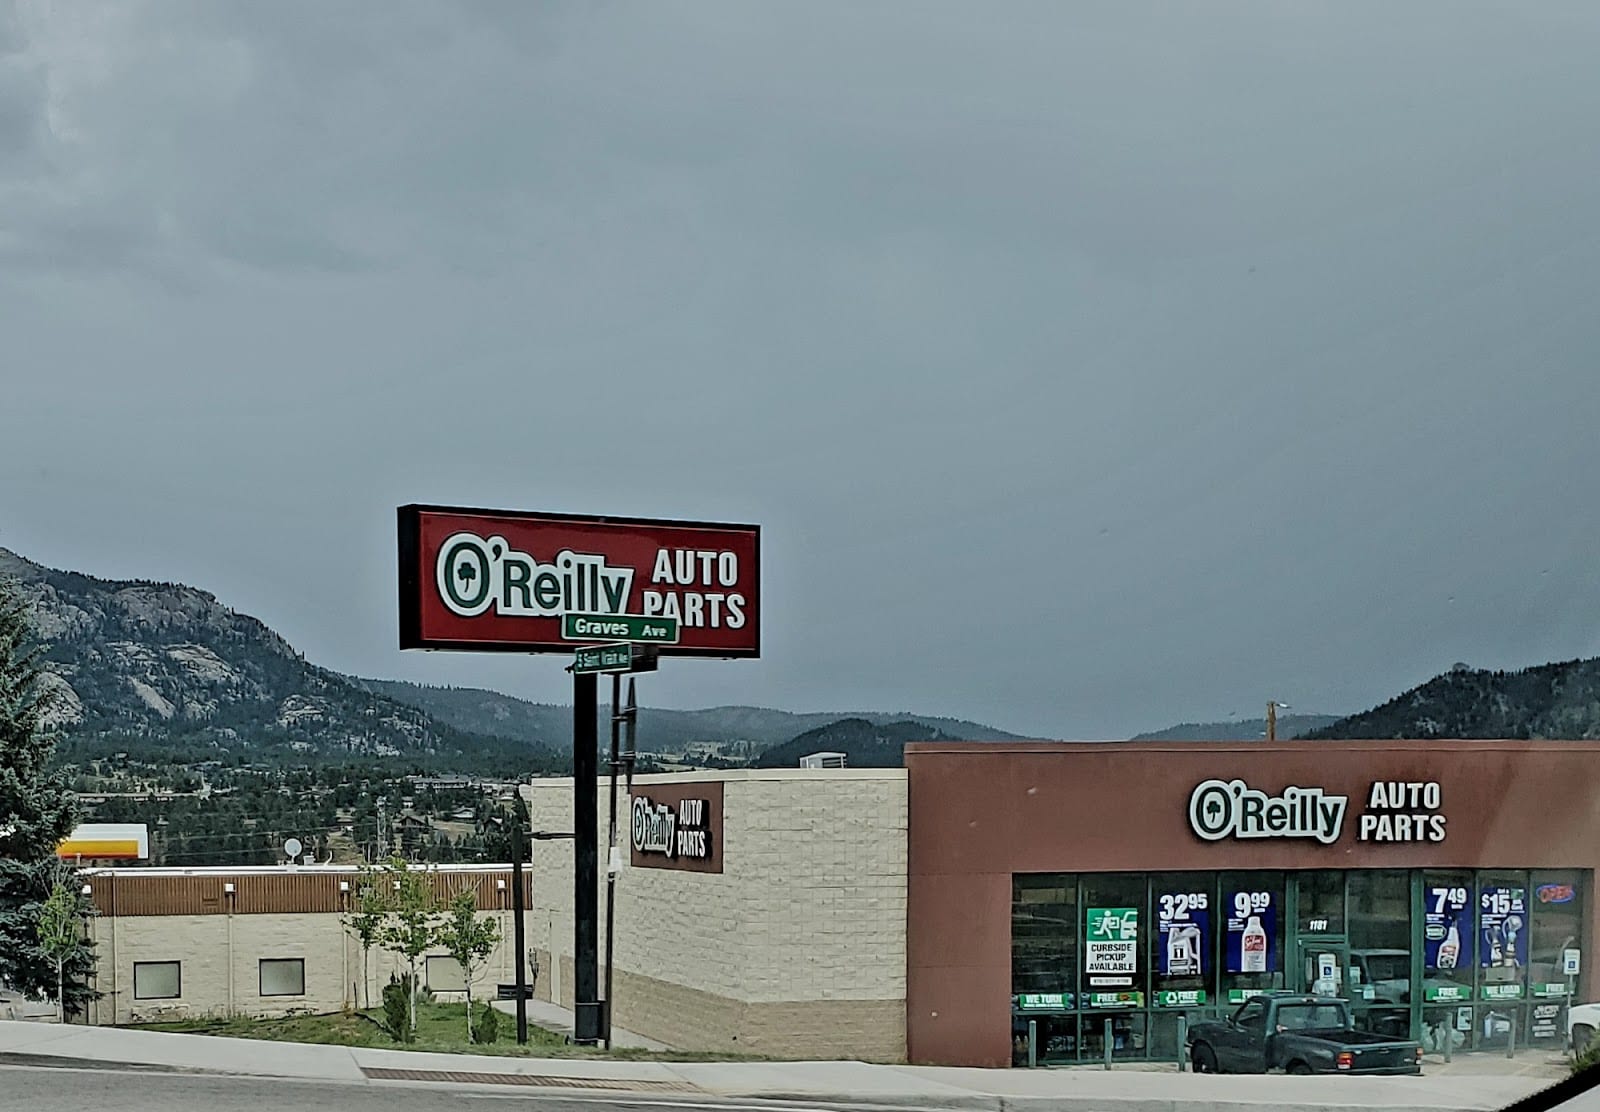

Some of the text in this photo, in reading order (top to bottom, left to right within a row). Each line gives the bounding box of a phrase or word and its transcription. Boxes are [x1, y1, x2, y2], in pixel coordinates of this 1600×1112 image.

[438, 535, 632, 615] O'Reilly
[652, 549, 738, 587] AUTO
[643, 591, 745, 629] PARTS
[574, 618, 667, 636] Graves Ave
[1371, 782, 1441, 809] AUTO
[679, 799, 703, 826] AUTO
[1191, 781, 1346, 841] O'Reilly
[1361, 814, 1446, 841] PARTS
[677, 830, 706, 857] PARTS
[1481, 893, 1511, 914] $15
[1091, 943, 1133, 952] CURBSIDE
[1096, 953, 1126, 961] PICKUP
[1088, 962, 1134, 971] AVAILABLE
[1025, 994, 1063, 1004] WE TURN
[1096, 993, 1118, 1003] FREE
[1177, 991, 1199, 1000] FREE
